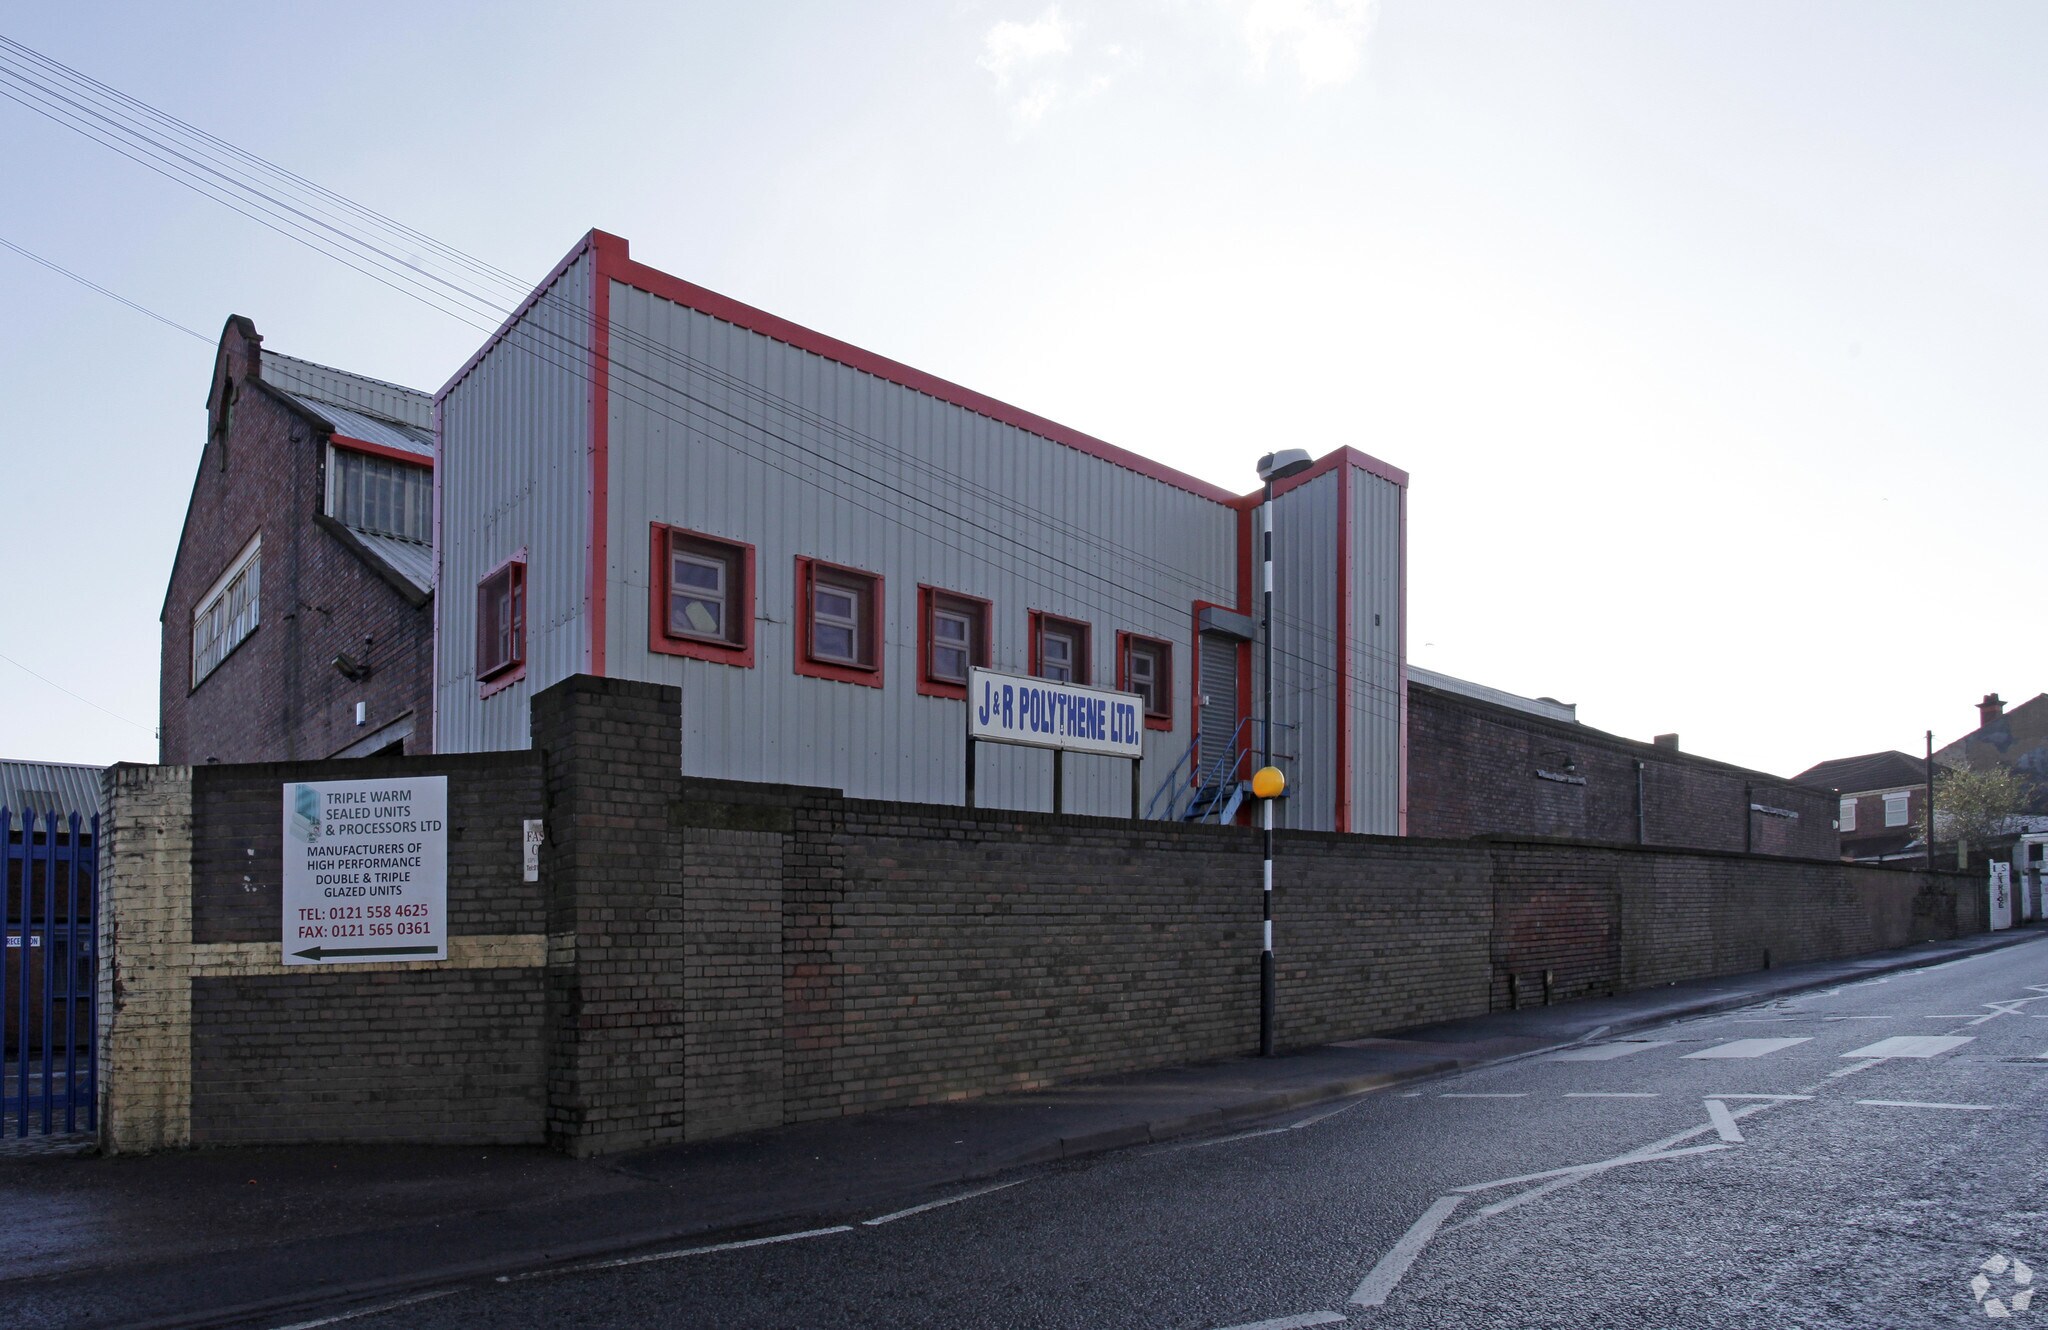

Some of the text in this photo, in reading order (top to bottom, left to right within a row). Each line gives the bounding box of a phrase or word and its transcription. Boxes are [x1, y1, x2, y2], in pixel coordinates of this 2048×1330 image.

[1019, 687, 1106, 740] POLYTHENE
[1111, 701, 1139, 746] LTD.
[327, 790, 412, 804] TRIPLE WARM
[326, 806, 411, 820] SEALED UNITS
[325, 820, 442, 836] & PROCESSORS LTD
[307, 843, 422, 856] MANUFACTURERS OF
[307, 857, 421, 870] HIGH PERFORMANCE
[316, 872, 410, 885] DOUBLE & TRIPLE
[324, 885, 402, 897] GLAZED UNITS
[298, 904, 428, 921] TEL: 0121 558 4625
[298, 922, 430, 938] FAX: 0121 565 0361
